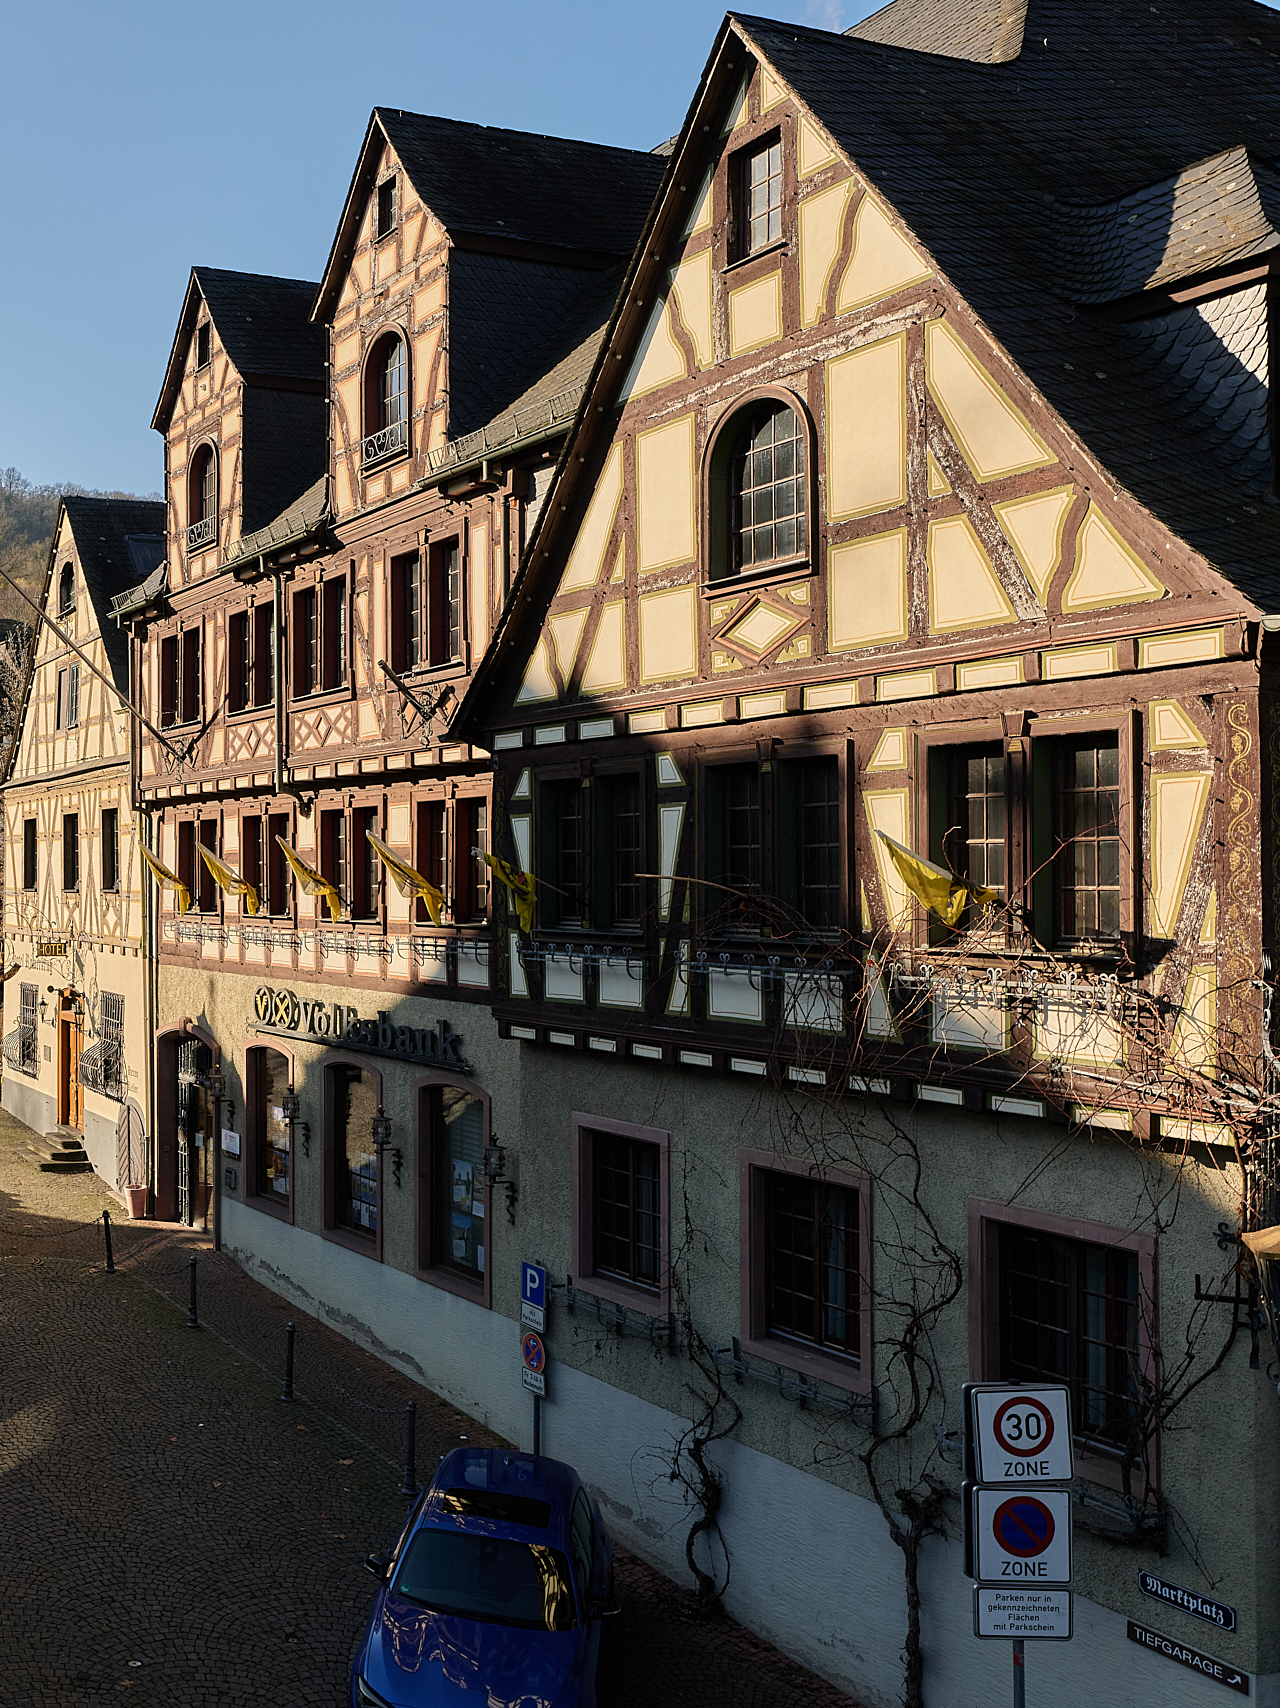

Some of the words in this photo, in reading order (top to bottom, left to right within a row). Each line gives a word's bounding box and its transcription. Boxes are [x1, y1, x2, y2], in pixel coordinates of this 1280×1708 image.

[38, 943, 66, 956] HOTEL
[297, 998, 463, 1063] Volksbank
[526, 1267, 539, 1297] P
[1006, 1412, 1041, 1441] 30
[1004, 1460, 1050, 1477] ZONE
[1001, 1561, 1048, 1577] ZONE
[995, 1593, 1024, 1602] Parken
[1044, 1594, 1052, 1602] in
[1146, 1576, 1224, 1625] Marktplatz
[987, 1603, 1060, 1613] gekennzeichneten
[1008, 1613, 1040, 1621] Flächen
[993, 1622, 1006, 1631] mit
[1009, 1623, 1054, 1631] Parkschein
[1133, 1626, 1223, 1679] TIEFGARAGE
